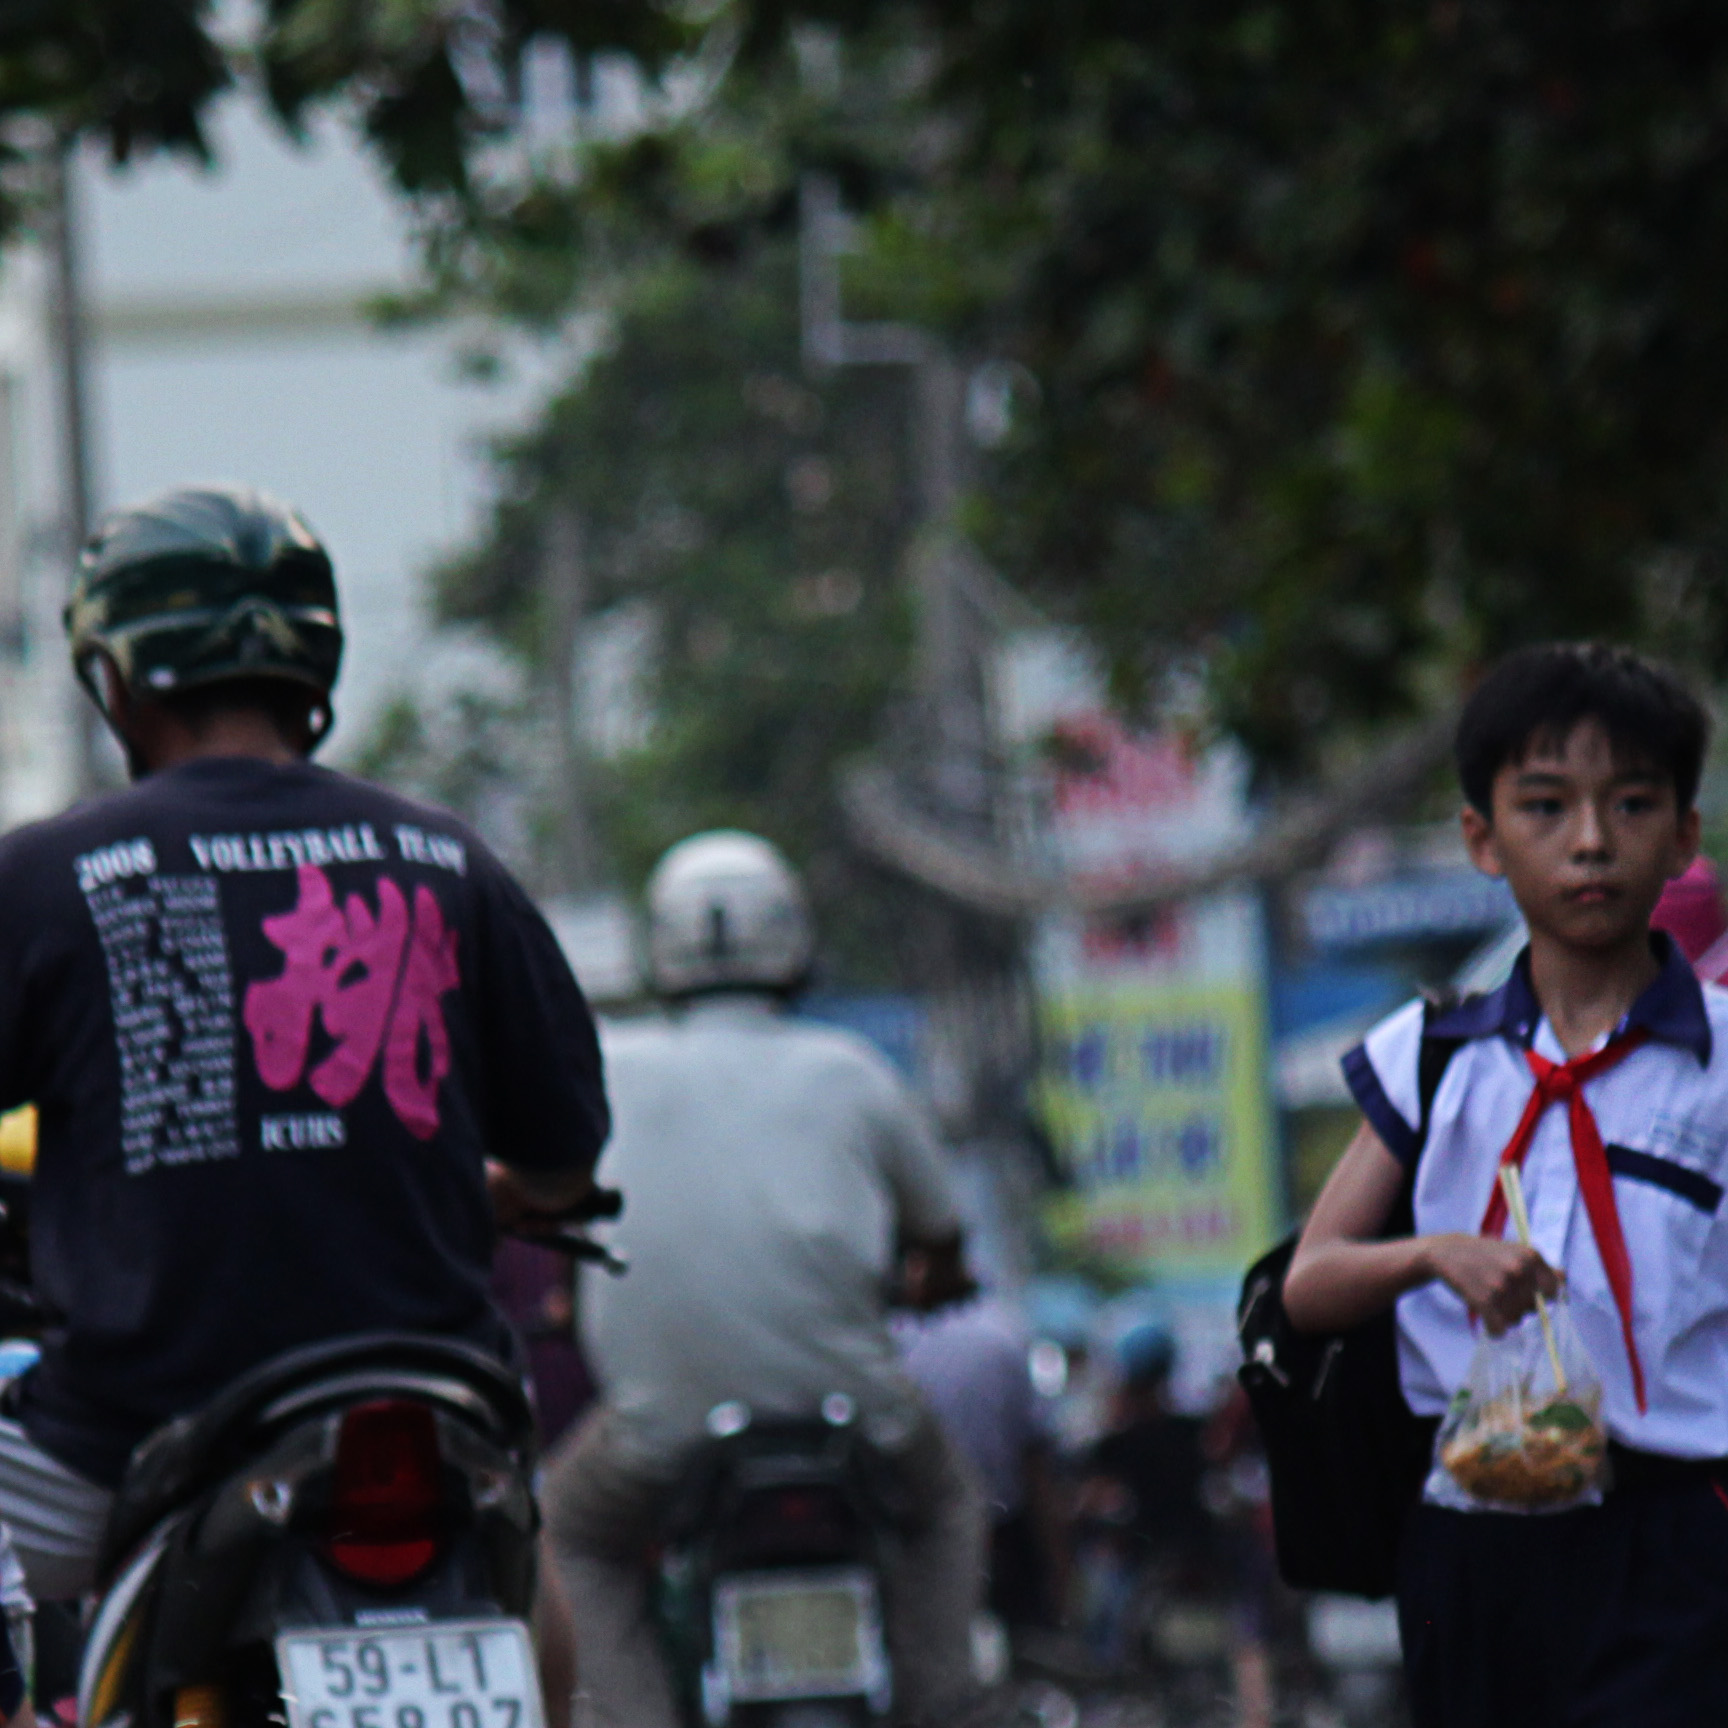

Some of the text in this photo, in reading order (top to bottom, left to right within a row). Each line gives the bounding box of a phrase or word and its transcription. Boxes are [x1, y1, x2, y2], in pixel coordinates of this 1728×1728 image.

[75, 822, 468, 893] 2008 VOLLEYBALL TEAM
[319, 1631, 488, 1698] 59-L1
